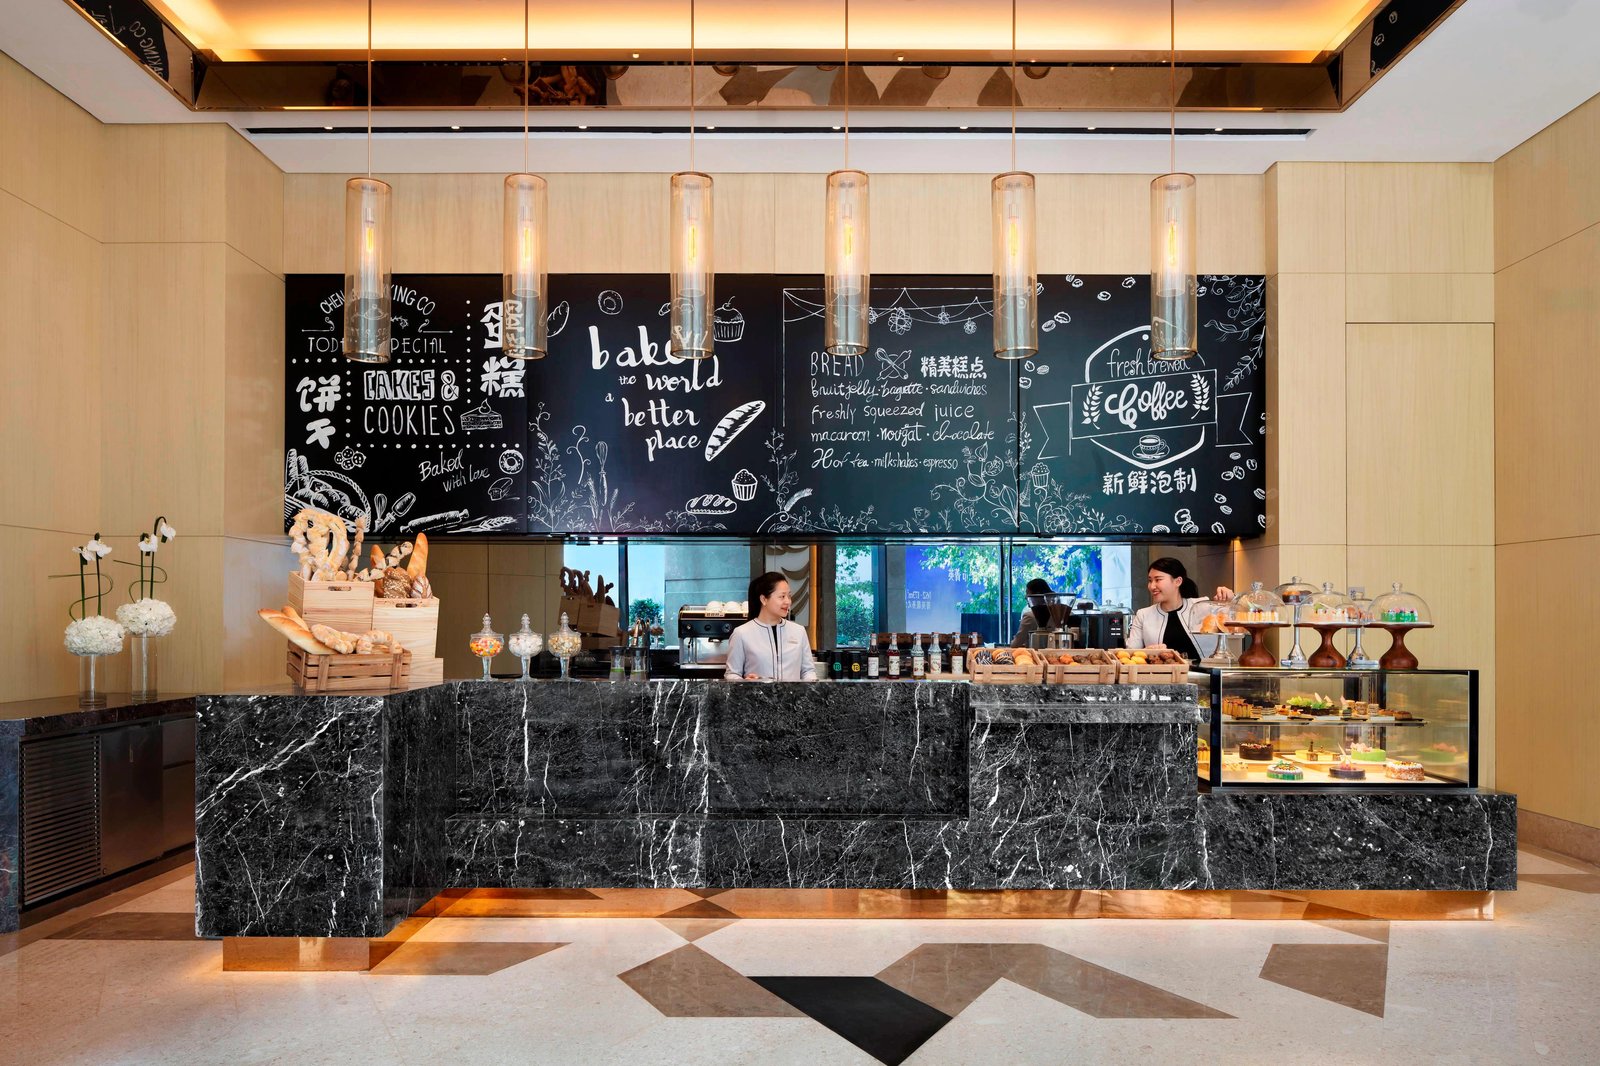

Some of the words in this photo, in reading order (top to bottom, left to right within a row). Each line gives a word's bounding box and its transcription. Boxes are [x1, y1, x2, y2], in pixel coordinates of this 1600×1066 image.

[319, 290, 345, 314] CHEN
[417, 296, 436, 316] CO
[391, 337, 447, 354] PECIAL
[618, 375, 637, 386] the
[645, 354, 723, 393] world
[810, 350, 866, 376] BREAD
[920, 355, 988, 380] 精美糕点
[1106, 347, 1146, 378] fresh
[363, 369, 435, 400] CAKES
[440, 369, 460, 400] &
[930, 379, 988, 396] sandwiches
[295, 374, 342, 450] 饼干
[363, 405, 456, 436] COOKIES
[604, 392, 615, 403] a
[621, 397, 700, 428] better
[811, 402, 857, 425] freshly
[864, 401, 926, 424] squeezed
[934, 403, 975, 422] juice
[1104, 381, 1189, 430] Coffee
[645, 429, 701, 462] place
[418, 448, 465, 482] Baked
[850, 452, 869, 468] tea
[874, 451, 919, 469] milkshakes
[923, 457, 959, 473] espresso
[443, 470, 467, 493] with
[469, 464, 491, 482] love
[1102, 467, 1197, 496] 新鲜泡制
